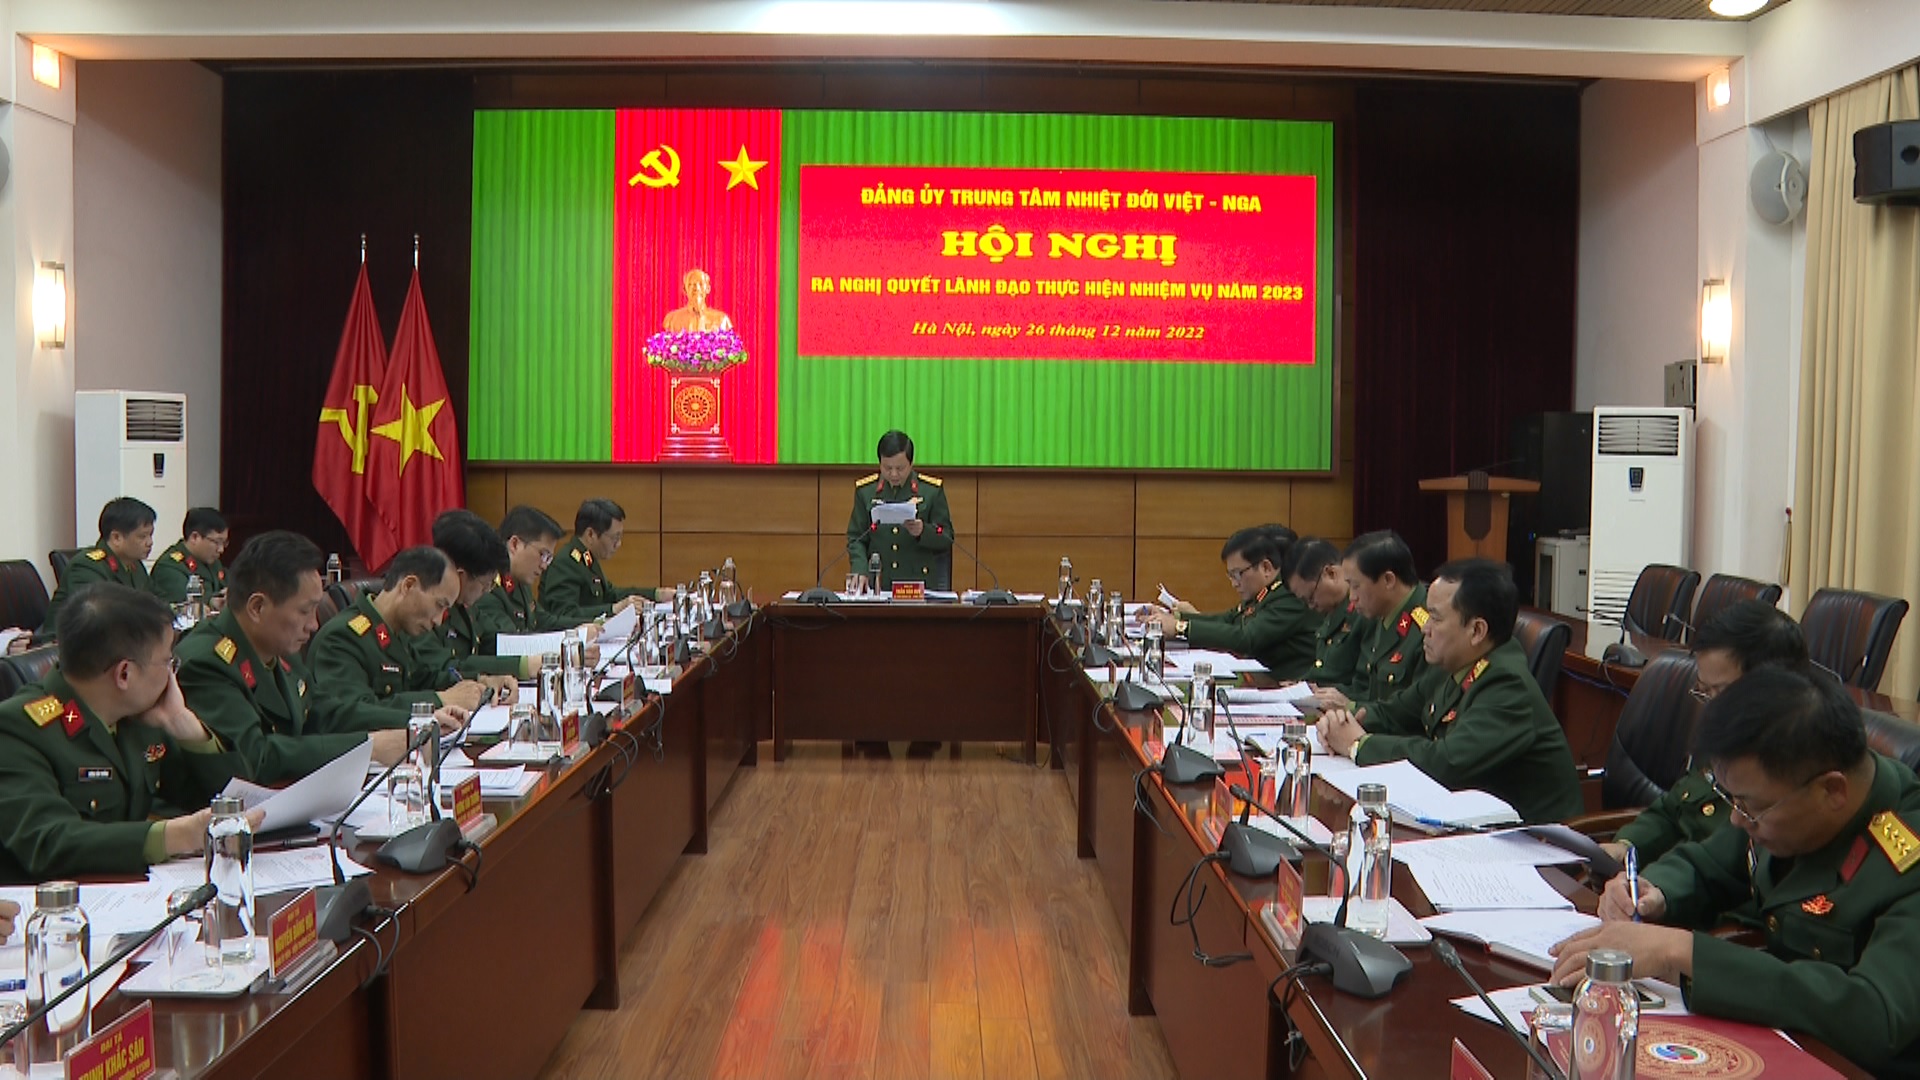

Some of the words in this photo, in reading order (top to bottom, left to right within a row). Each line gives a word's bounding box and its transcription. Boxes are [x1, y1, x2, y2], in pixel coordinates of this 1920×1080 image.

[861, 182, 915, 206] ĐẢNG
[920, 183, 945, 205] ỦY
[950, 189, 1014, 207] TRUNG
[1019, 187, 1061, 207] TÂM
[1066, 189, 1122, 211] NHIỆT
[1126, 189, 1159, 210] ĐỚI
[1163, 191, 1205, 214] VIỆT
[1222, 195, 1262, 213] NGA
[941, 224, 1034, 263] HỘI
[1047, 232, 1177, 267] NGHỊ
[811, 277, 835, 293] RA
[839, 277, 882, 296] NGHỊ
[886, 274, 941, 295] QUYẾT
[945, 276, 991, 295] LÃNH
[995, 279, 1031, 298] ĐẠO
[1035, 279, 1080, 299] THỰC
[1084, 279, 1125, 300] HIỆN
[1129, 280, 1186, 301] NHIỆM
[1190, 283, 1213, 302] VỤ
[1217, 282, 1258, 300] NĂM
[1261, 285, 1303, 301] 2023
[912, 322, 937, 336] Hà
[941, 322, 976, 338] Nội,
[981, 323, 1022, 339] ngày
[1026, 323, 1045, 337] 26
[1049, 323, 1097, 339] tháng
[1102, 325, 1121, 338] 12
[1125, 326, 1161, 339] năm
[1165, 327, 1205, 339] 2022
